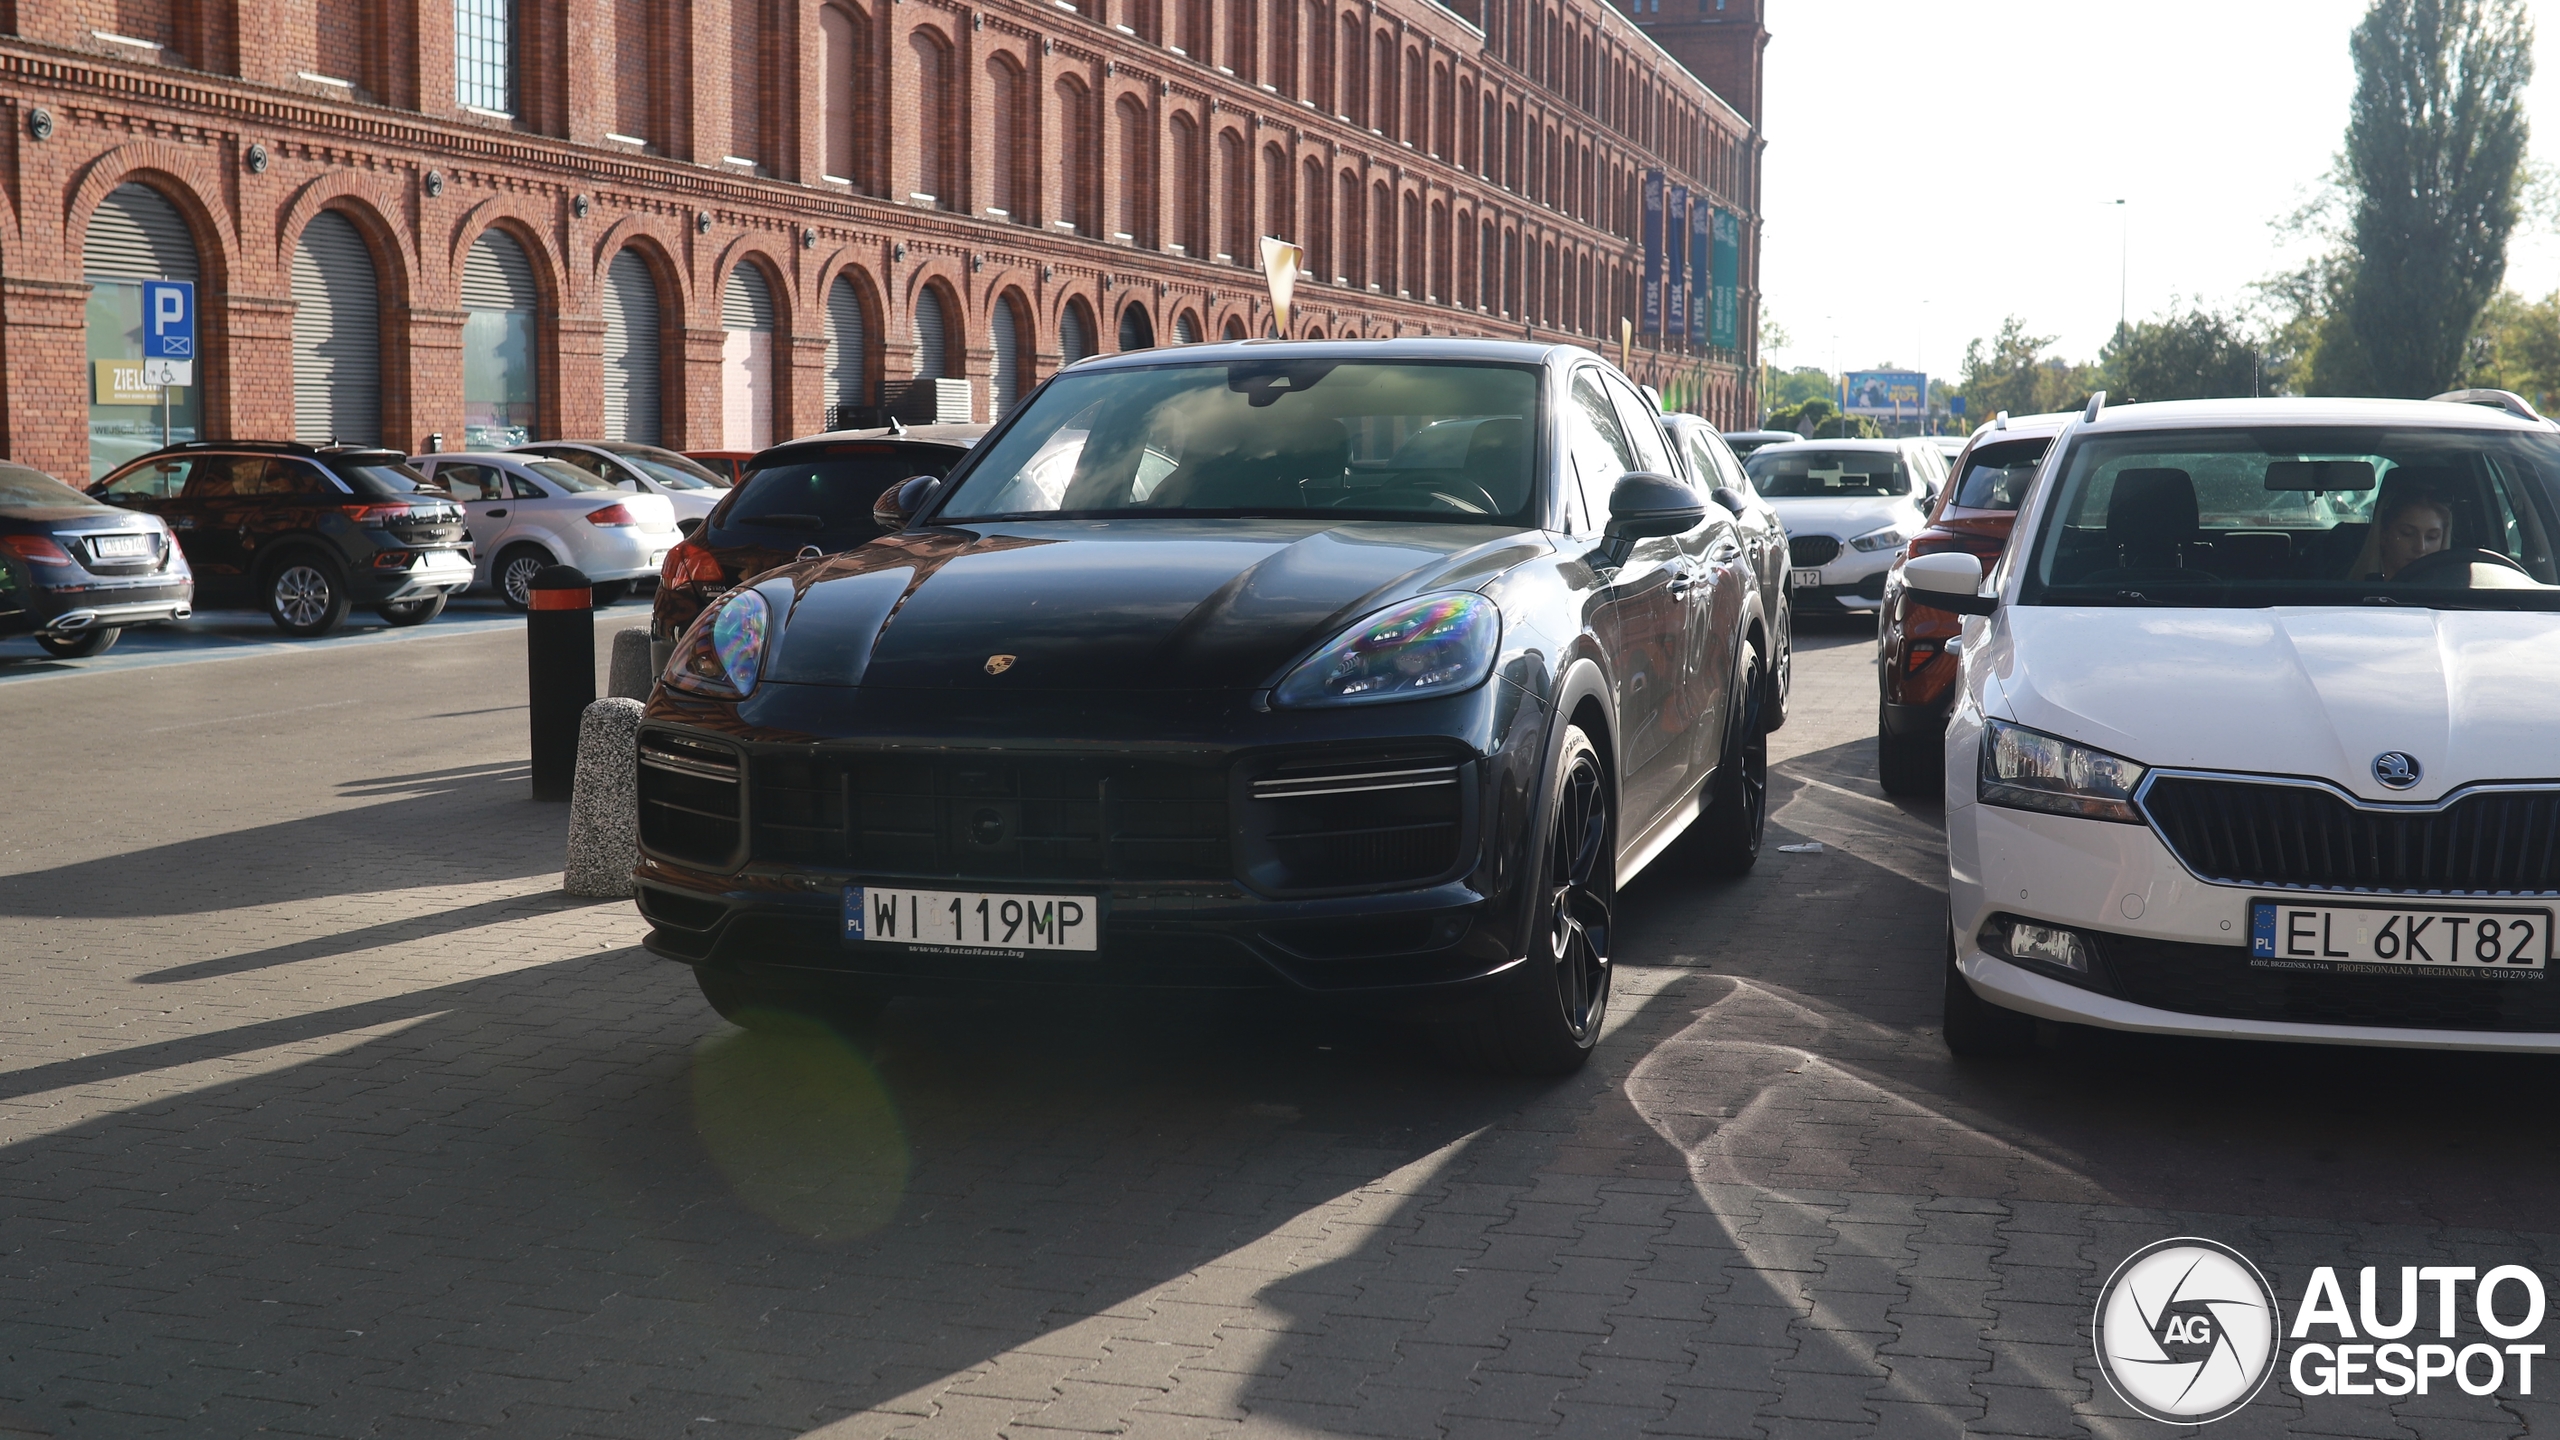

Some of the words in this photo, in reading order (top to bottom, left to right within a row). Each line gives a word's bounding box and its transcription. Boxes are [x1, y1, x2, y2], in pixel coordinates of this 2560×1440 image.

[1647, 281, 1658, 315] JYSK
[1672, 284, 1682, 316] JYSK
[155, 287, 183, 336] P
[1693, 297, 1704, 328] JYSK
[848, 919, 862, 932] PL
[874, 893, 917, 939] WI
[949, 897, 1084, 945] 119MP
[2256, 938, 2272, 950] PL
[2287, 911, 2349, 958] EL
[2374, 915, 2535, 965] 6KT82
[909, 945, 1025, 958] www.AutoHaus.bg
[2271, 960, 2311, 969] BRZEZIŃSKA
[2337, 963, 2414, 976] PROFESJONALNA
[2417, 967, 2475, 977] MECHANIKA
[2492, 970, 2508, 978] 510
[2510, 970, 2526, 979] 279
[2528, 971, 2544, 980] 596
